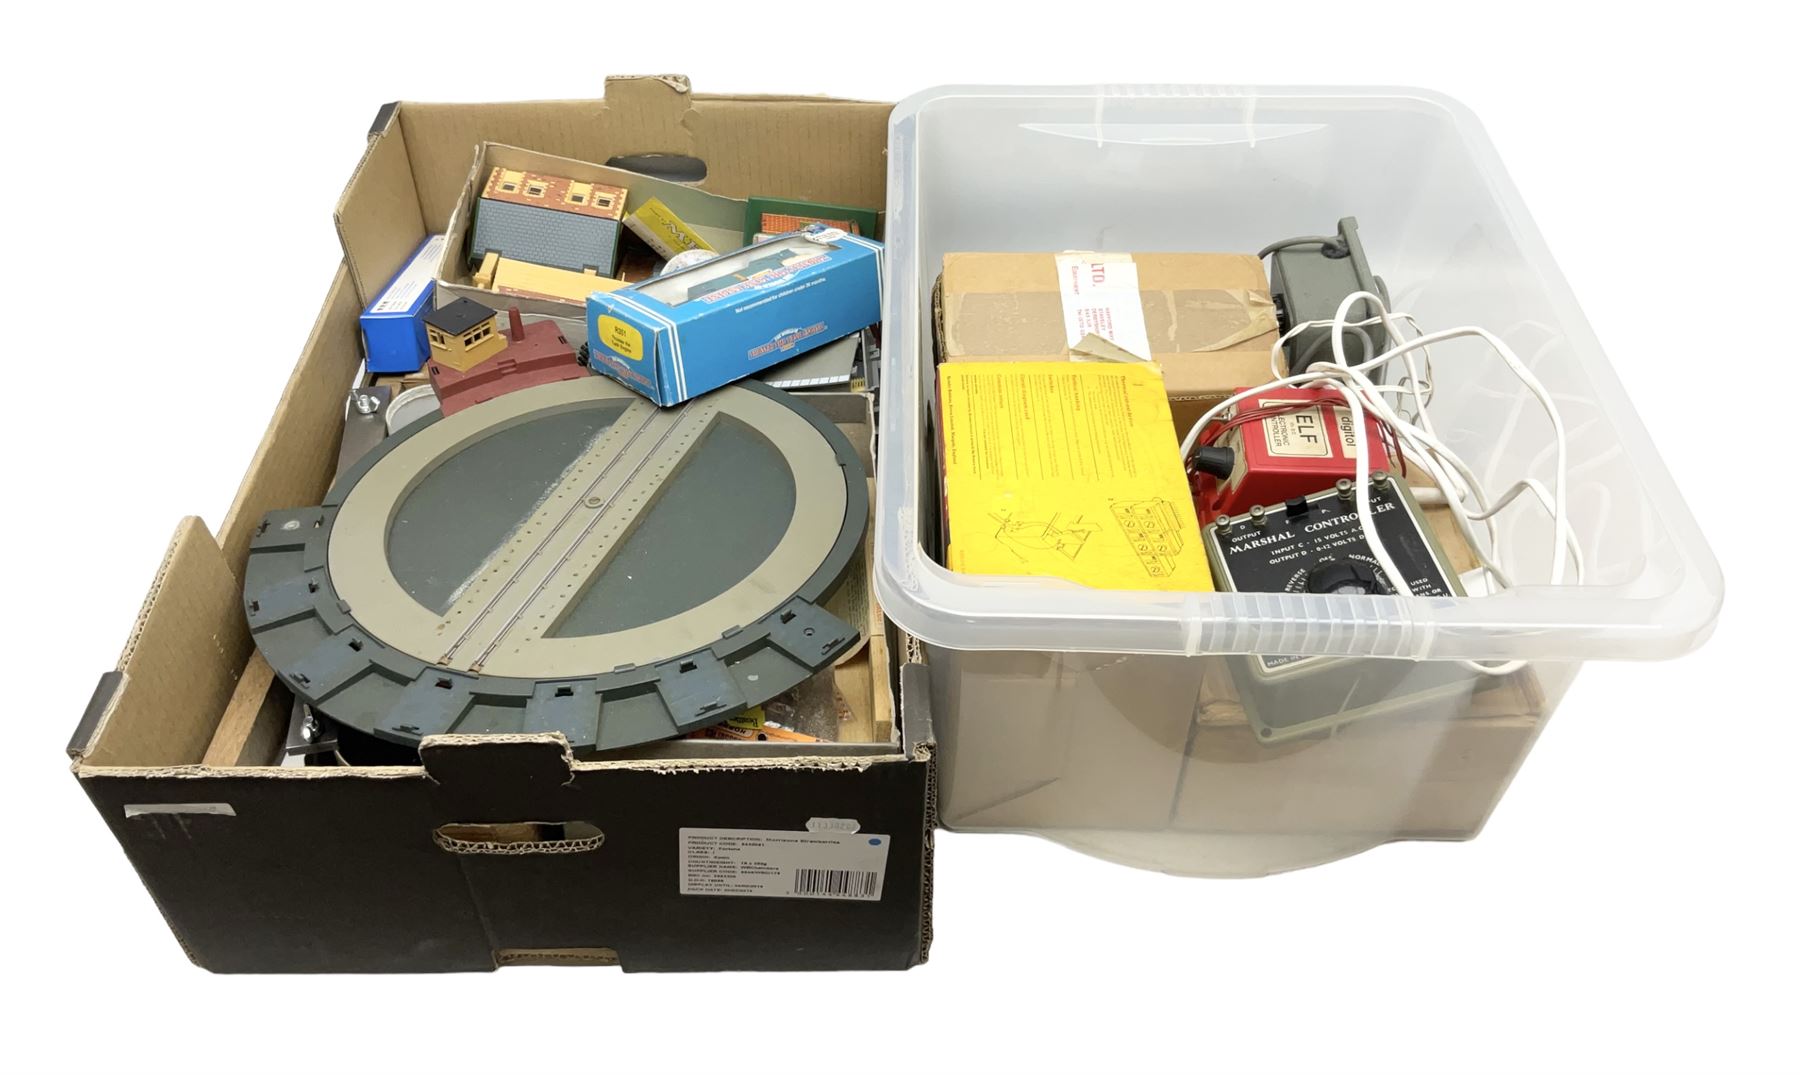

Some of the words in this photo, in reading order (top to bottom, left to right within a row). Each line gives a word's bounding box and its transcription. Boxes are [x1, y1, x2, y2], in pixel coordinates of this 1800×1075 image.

[1091, 263, 1105, 287] LTD.
[1271, 417, 1282, 447] NTROLLER
[1277, 415, 1290, 446] LECTRONIC
[1296, 415, 1318, 444] ELF
[1229, 531, 1296, 555] MARSHAL
[1304, 502, 1396, 534] CONTROER
[1232, 531, 1262, 543] OUTPUT
[1269, 554, 1300, 565] OUTPUT
[1332, 536, 1357, 547] VOLTS
[1271, 544, 1296, 556] INPUT
[1314, 536, 1322, 544] 15
[1324, 530, 1349, 541] VOLTS
[1284, 568, 1307, 592] REVERSE
[1410, 577, 1428, 586] USED
[1411, 583, 1432, 593] WITH
[1267, 657, 1289, 667] MADE
